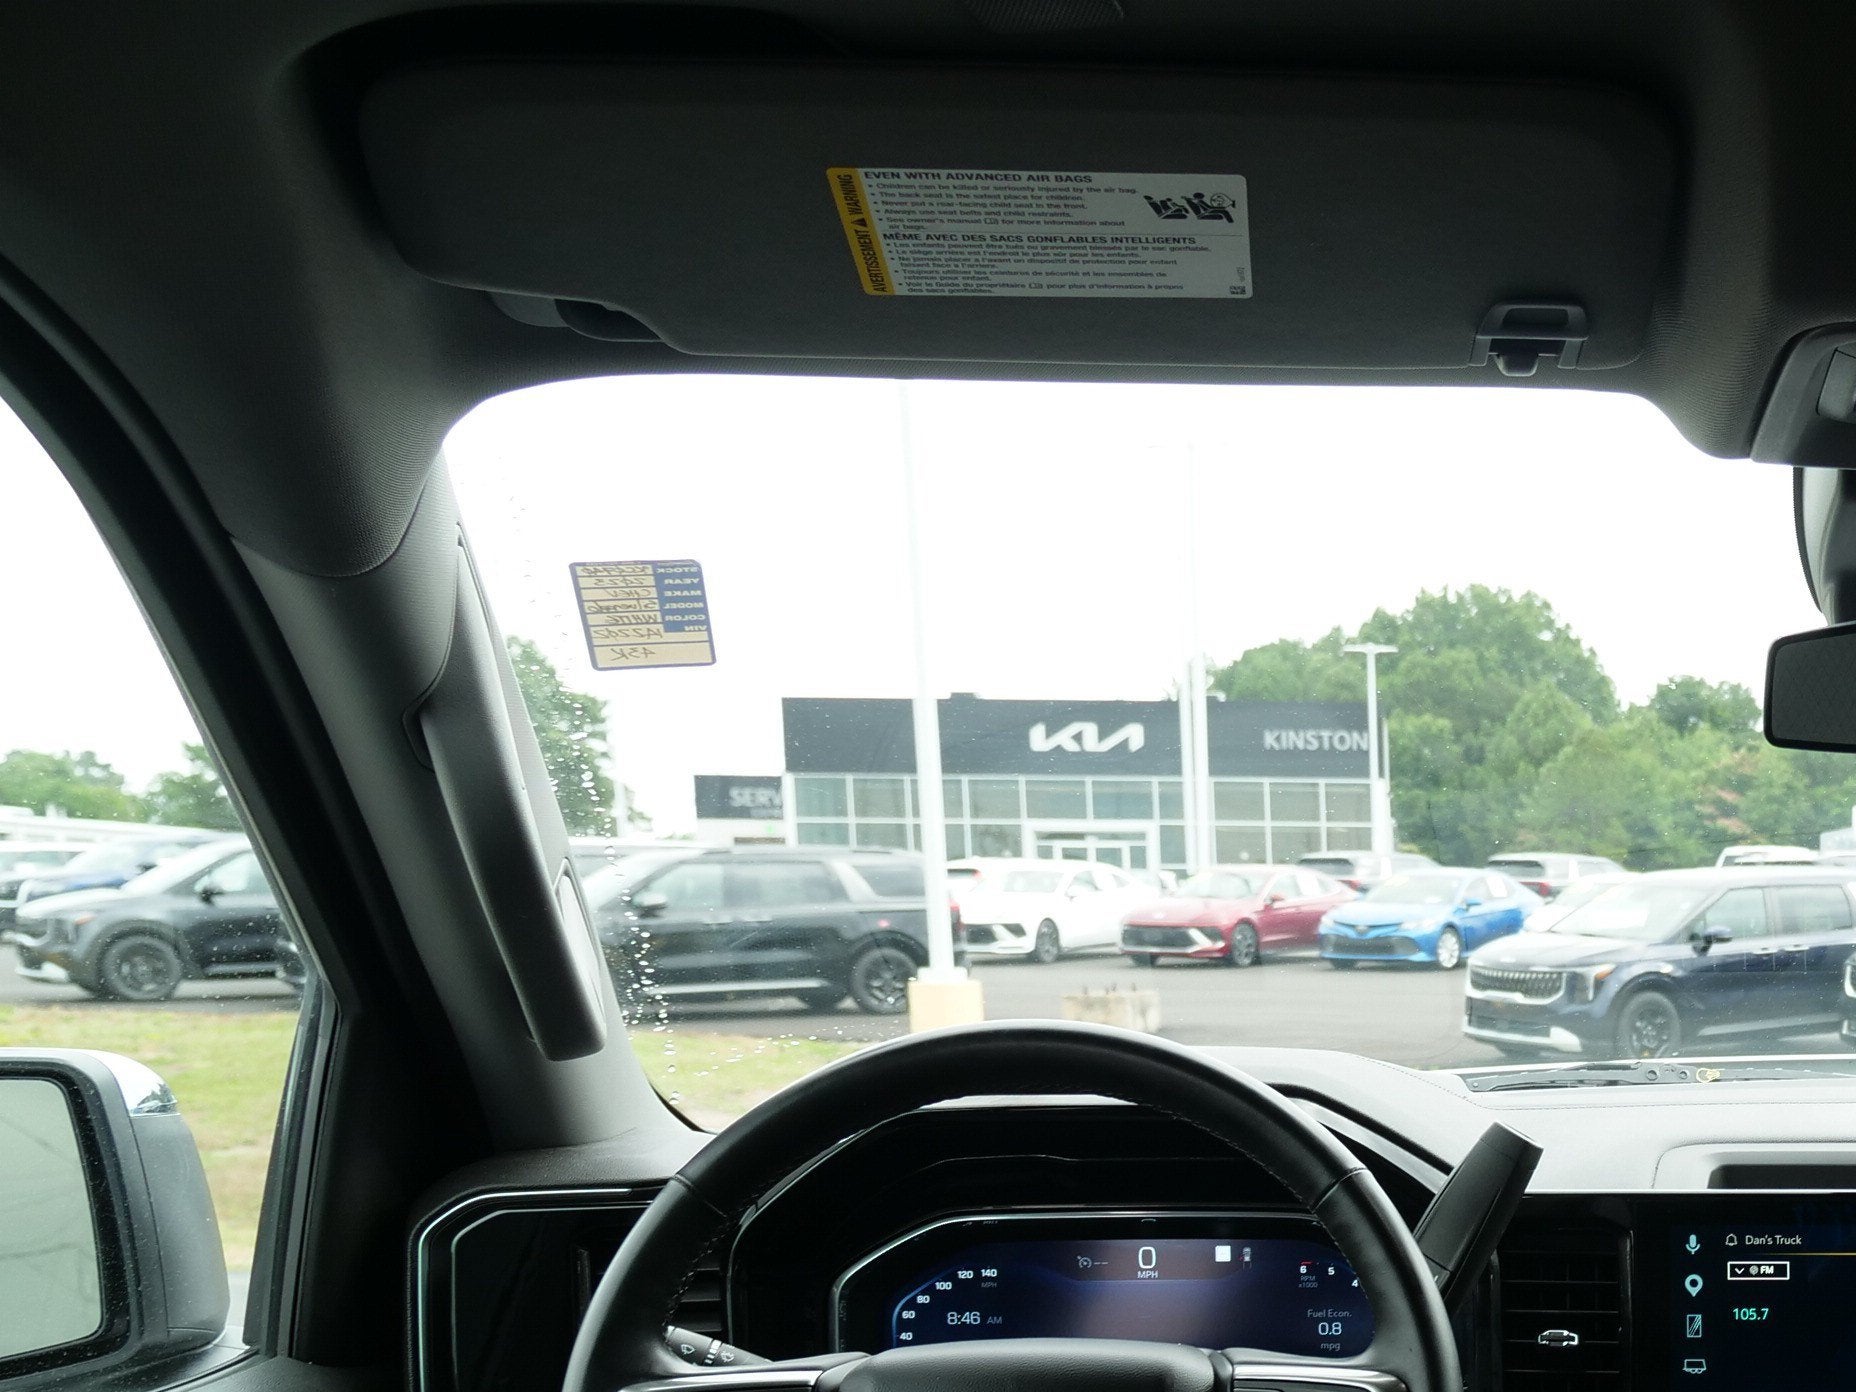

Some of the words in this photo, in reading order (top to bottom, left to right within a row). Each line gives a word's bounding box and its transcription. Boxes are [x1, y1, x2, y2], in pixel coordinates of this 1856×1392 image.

[905, 172, 941, 180] WITH
[946, 172, 1021, 181] ADVANCED
[1027, 174, 1050, 182] AIR
[1055, 175, 1092, 183] BAGS
[838, 174, 862, 216] WARNING
[883, 232, 922, 241] MÊME
[926, 234, 958, 242] AVEC
[1028, 236, 1107, 244] GONFLABLES
[1110, 236, 1196, 244] INTELLIGENTS
[856, 229, 888, 293] AVERTISSEMENT
[1028, 721, 1145, 752] KIA
[1263, 729, 1369, 752] KINSTON
[728, 786, 783, 807] SERV
[1745, 1234, 1773, 1245] Dan's
[1775, 1234, 1802, 1245] Truck
[1138, 1246, 1156, 1268] 0
[981, 1269, 997, 1277] 140
[1328, 1267, 1335, 1275] 5
[1760, 1265, 1774, 1274] FM
[935, 1282, 952, 1290] 100
[902, 1311, 915, 1319] 60
[947, 1312, 980, 1324] 8:46
[1732, 1308, 1769, 1320] 105.7
[1318, 1322, 1342, 1335] 0.8
[899, 1332, 913, 1340] 40
[1320, 1343, 1341, 1351] mpg
